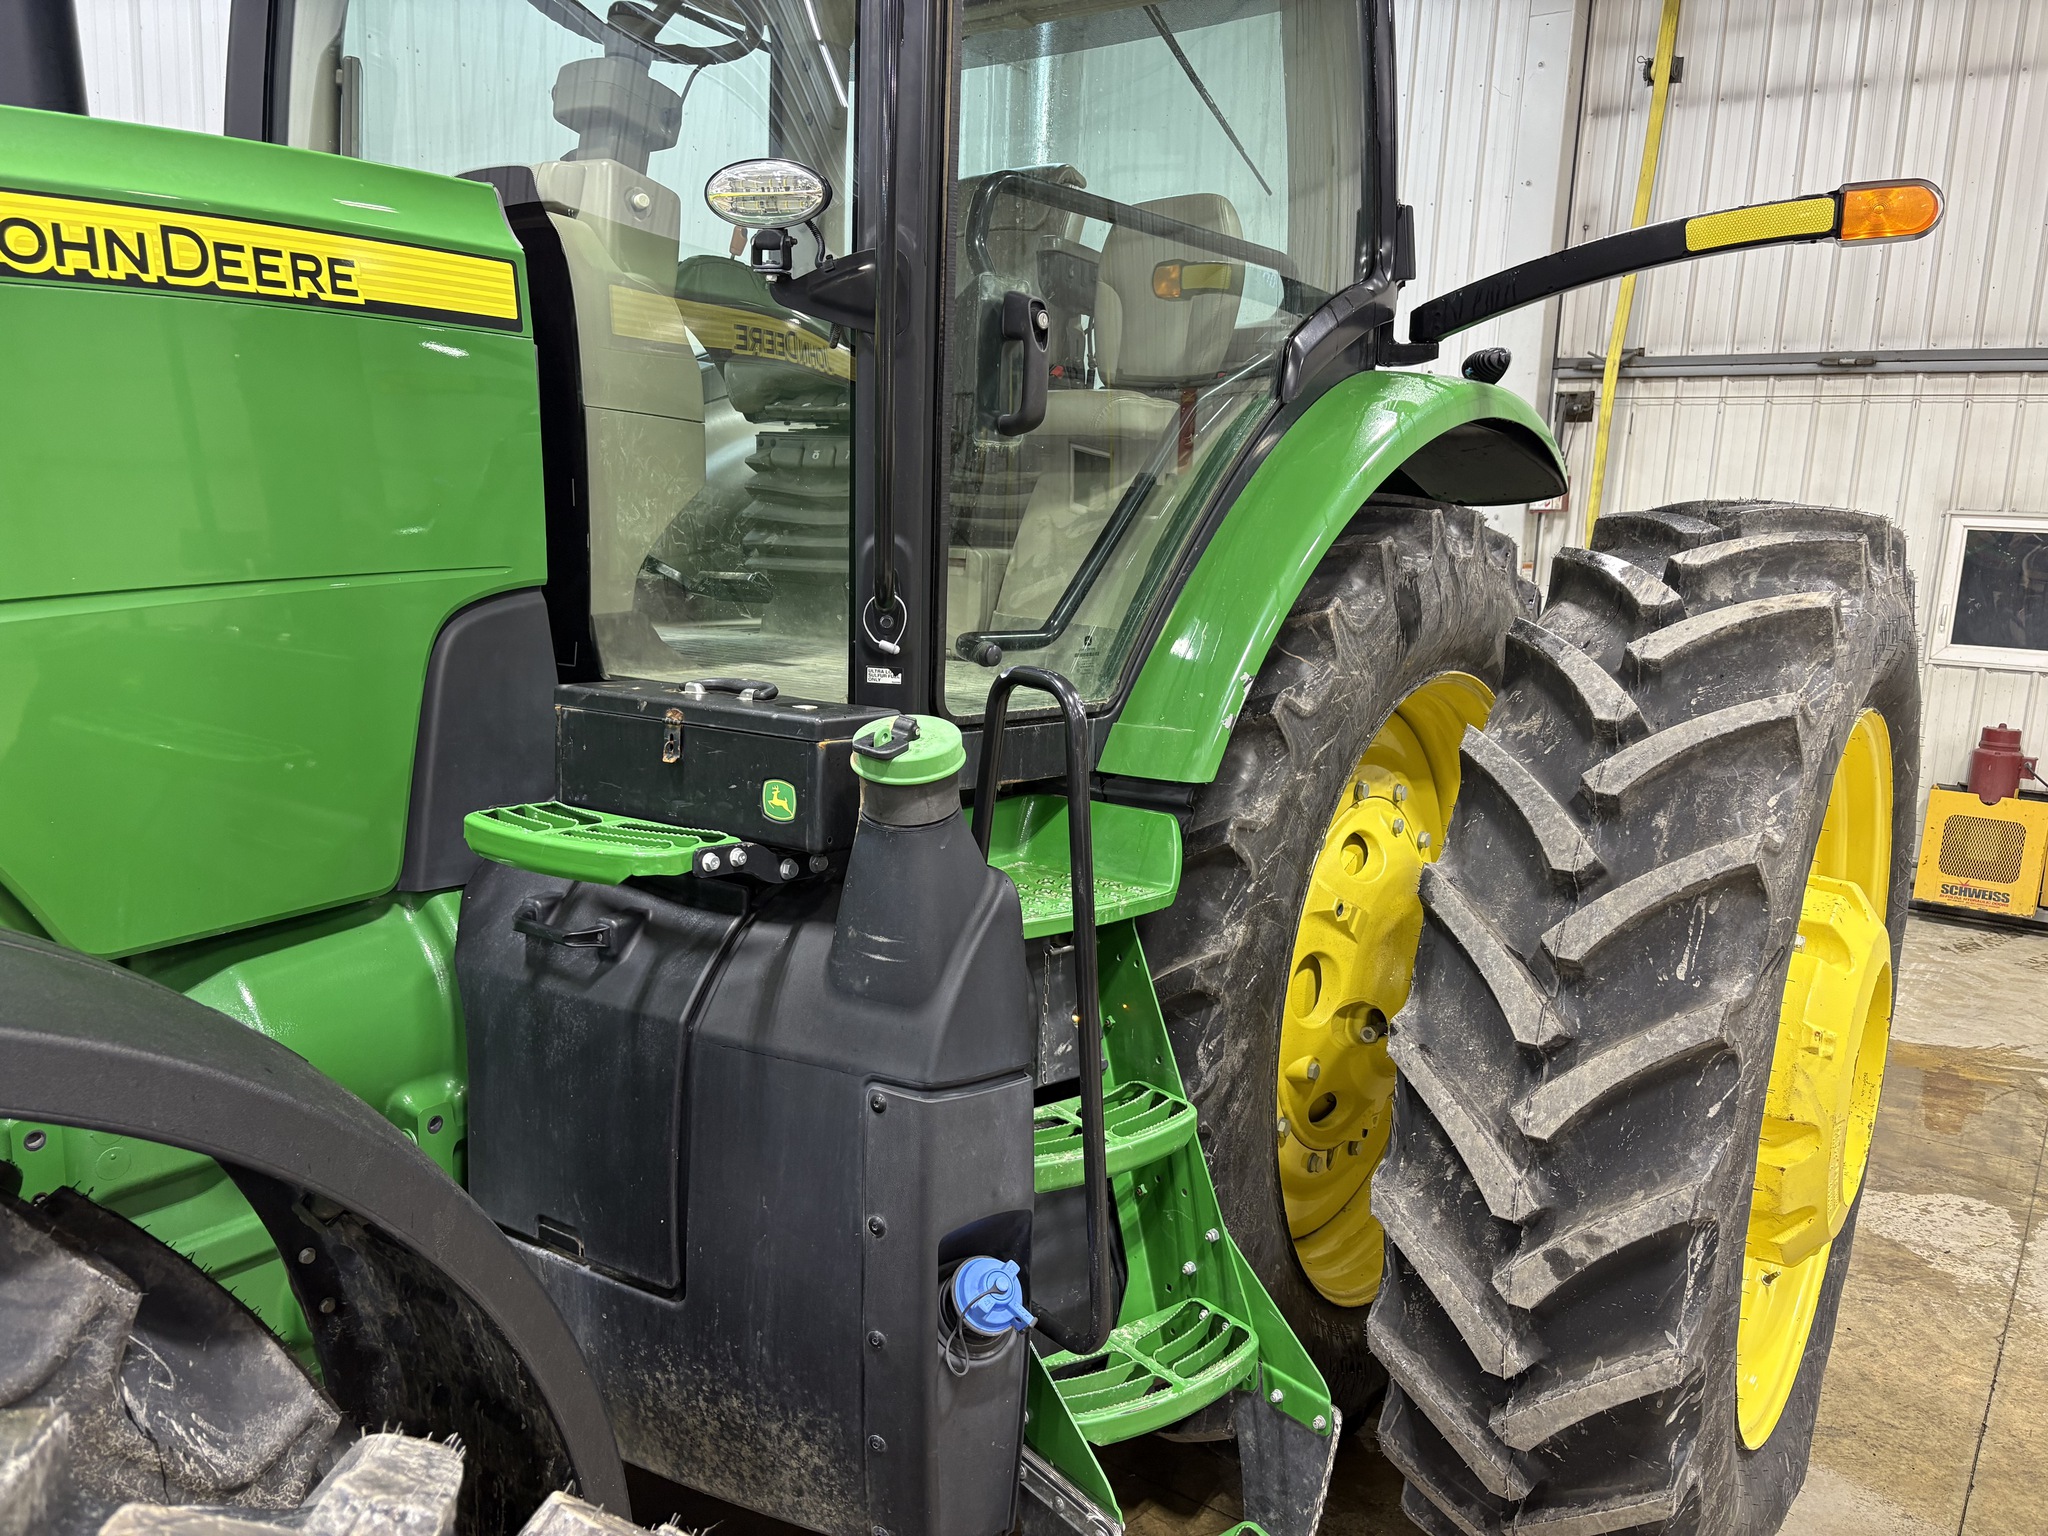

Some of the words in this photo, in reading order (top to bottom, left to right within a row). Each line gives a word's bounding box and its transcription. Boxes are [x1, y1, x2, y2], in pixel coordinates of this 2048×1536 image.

[0, 217, 151, 275] OHN
[159, 223, 360, 298] DEERE
[1940, 884, 2010, 903] SCHWEISS
